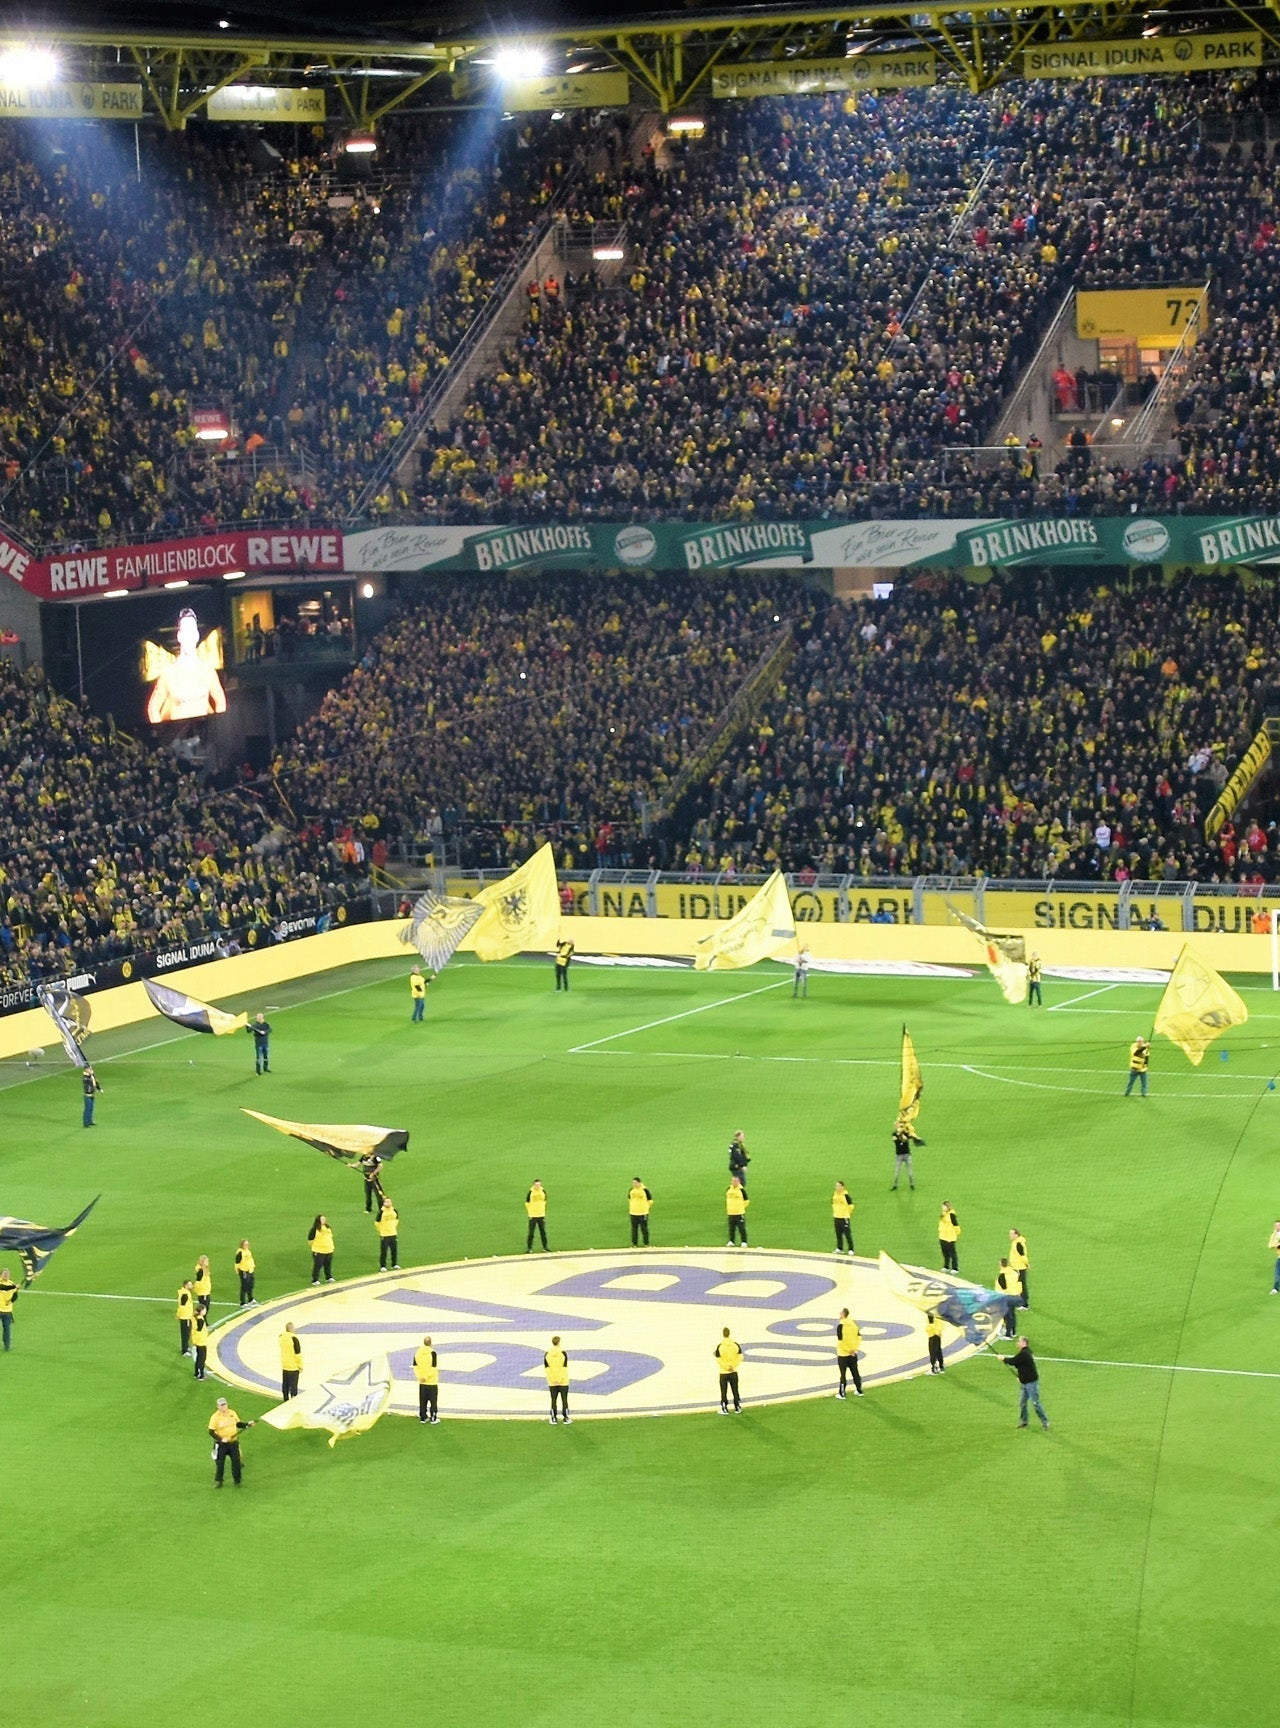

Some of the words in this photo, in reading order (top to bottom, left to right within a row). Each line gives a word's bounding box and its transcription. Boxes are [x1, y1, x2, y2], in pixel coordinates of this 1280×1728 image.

[1031, 52, 1099, 70] SIGNAL
[1105, 47, 1163, 66] IDUNA
[1204, 41, 1255, 60] PARK
[719, 72, 780, 89] SIGNAL
[882, 60, 929, 79] PARK
[30, 90, 72, 109] IDUNA
[102, 91, 138, 110] PARK
[297, 98, 322, 112] PARK
[1166, 299, 1200, 326] 73
[247, 535, 339, 566] REWE
[50, 557, 109, 592] REWE
[116, 544, 236, 580] FAMILIENBLOCK
[680, 893, 755, 919] IDU
[1034, 901, 1169, 931] SIGNAL
[288, 916, 316, 933] EVONIK
[156, 949, 188, 968] SIGNAL
[189, 941, 215, 960] IDUNA
[294, 1265, 837, 1396] BVB
[742, 1317, 916, 1367] 09
